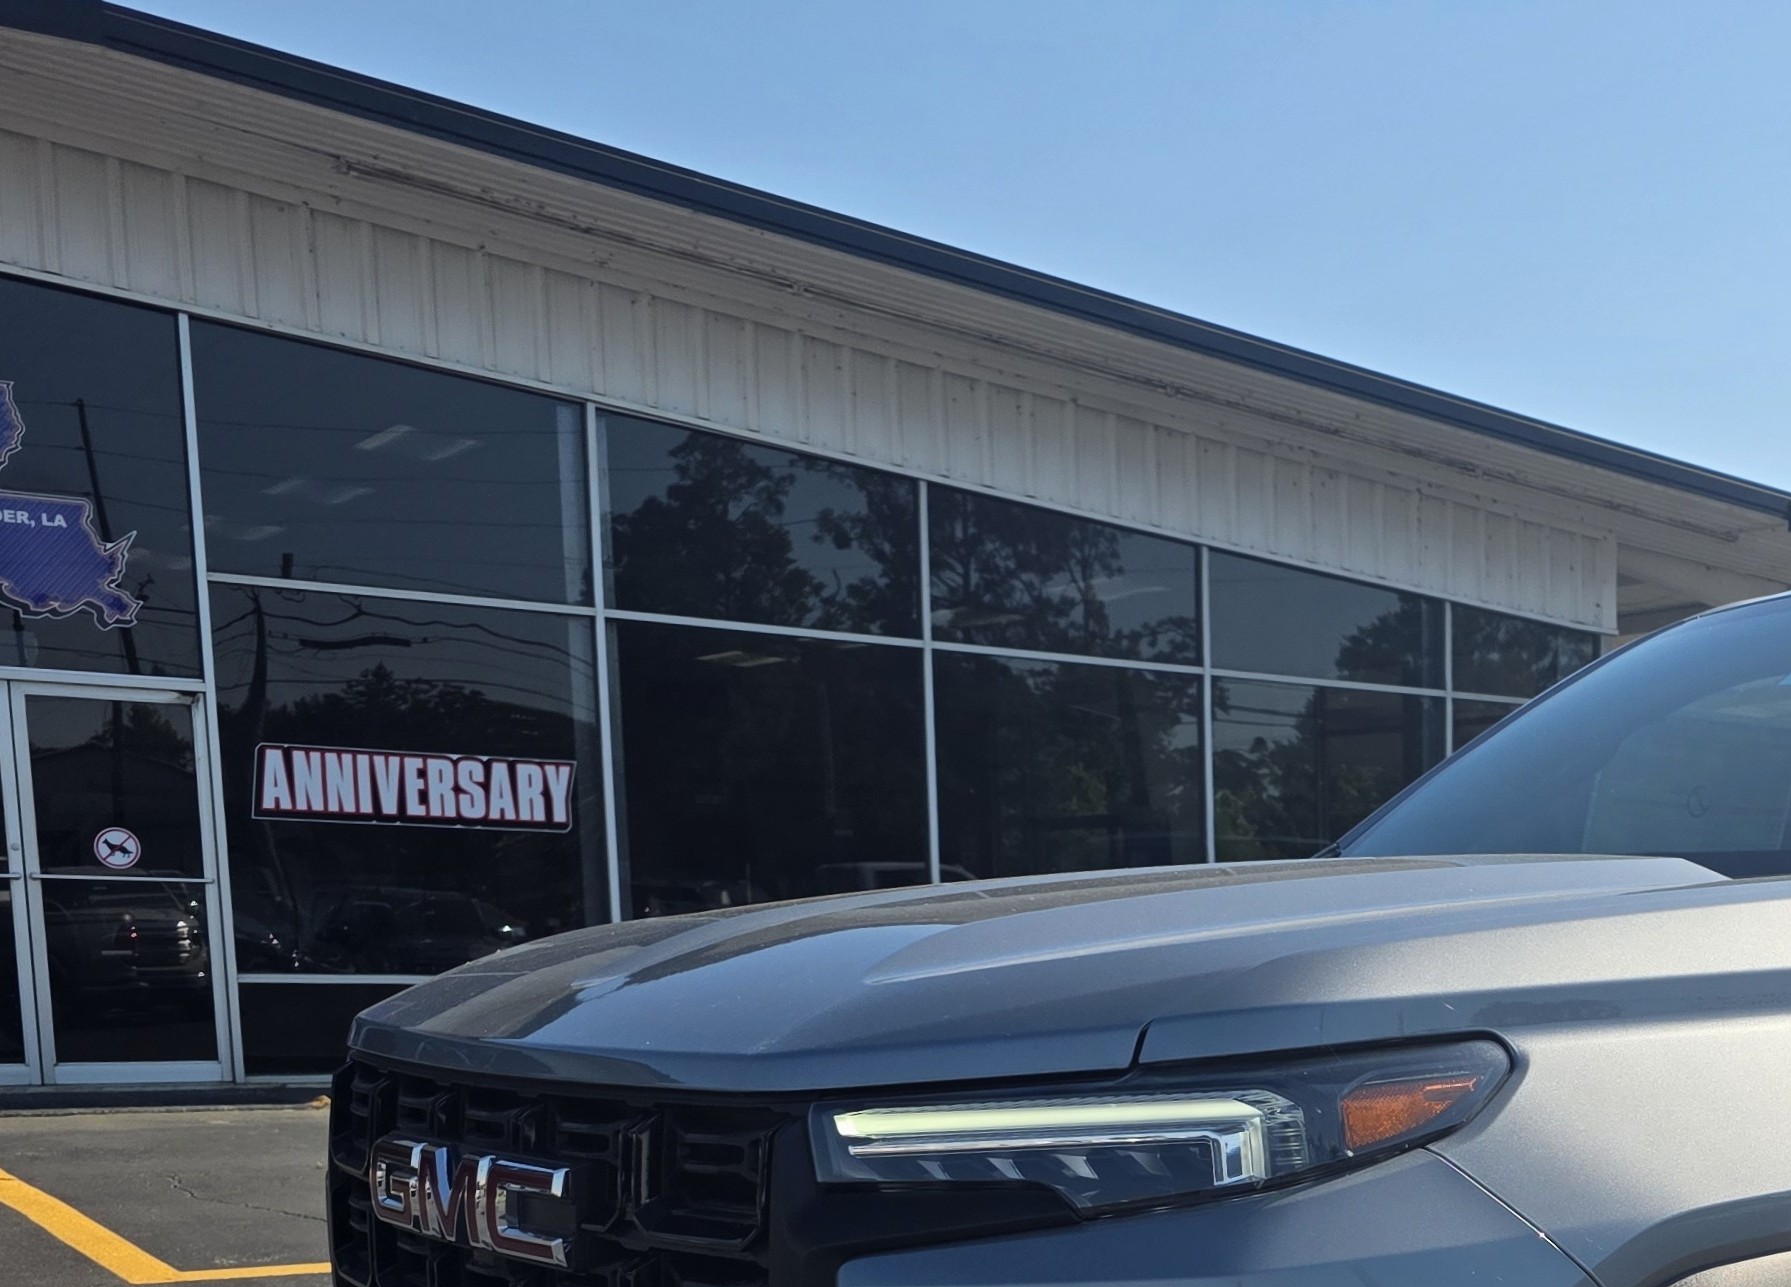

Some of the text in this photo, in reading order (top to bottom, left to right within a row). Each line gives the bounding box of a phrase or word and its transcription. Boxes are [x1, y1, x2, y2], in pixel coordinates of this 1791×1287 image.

[41, 513, 68, 528] LA
[262, 748, 571, 823] ANNIVERSARY
[369, 1141, 571, 1268] GMC
